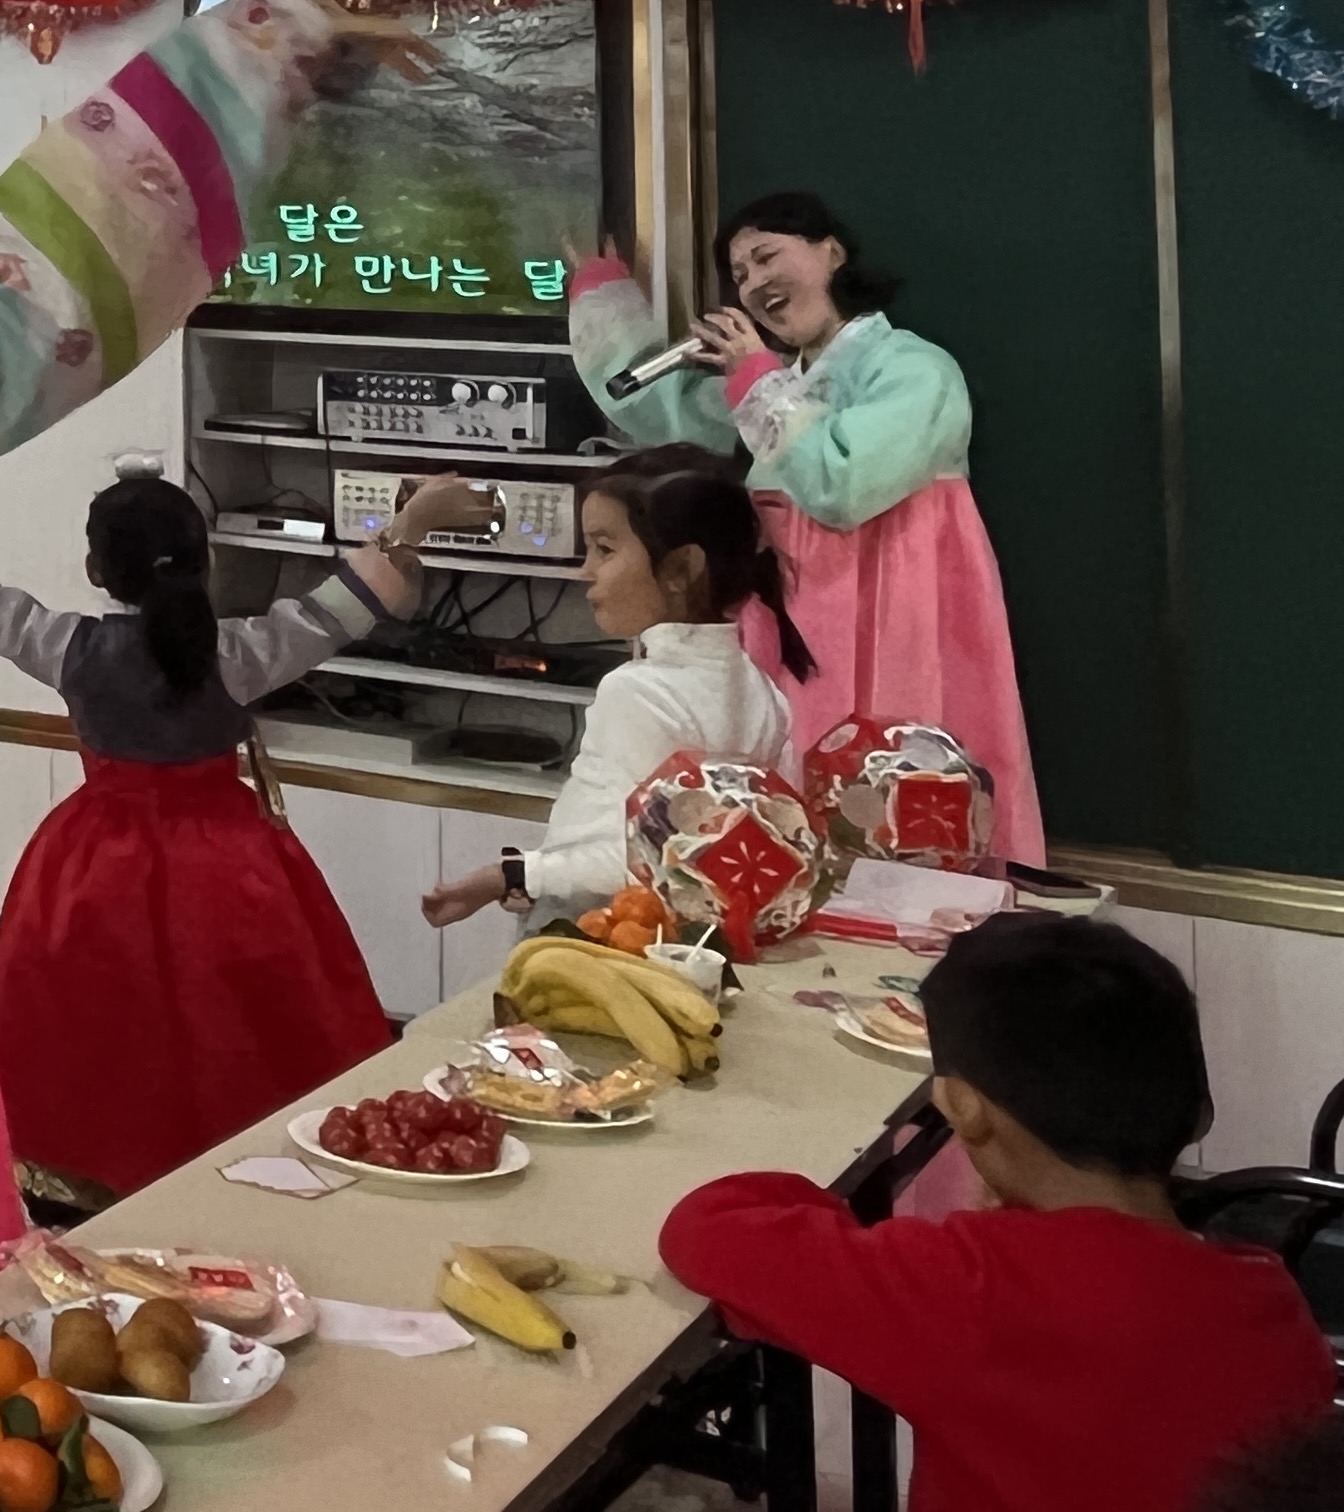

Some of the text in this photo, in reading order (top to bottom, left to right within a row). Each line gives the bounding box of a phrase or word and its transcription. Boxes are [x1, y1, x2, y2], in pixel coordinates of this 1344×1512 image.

[278, 203, 364, 244] 달은
[223, 251, 568, 302] 녀가 만나는 달
